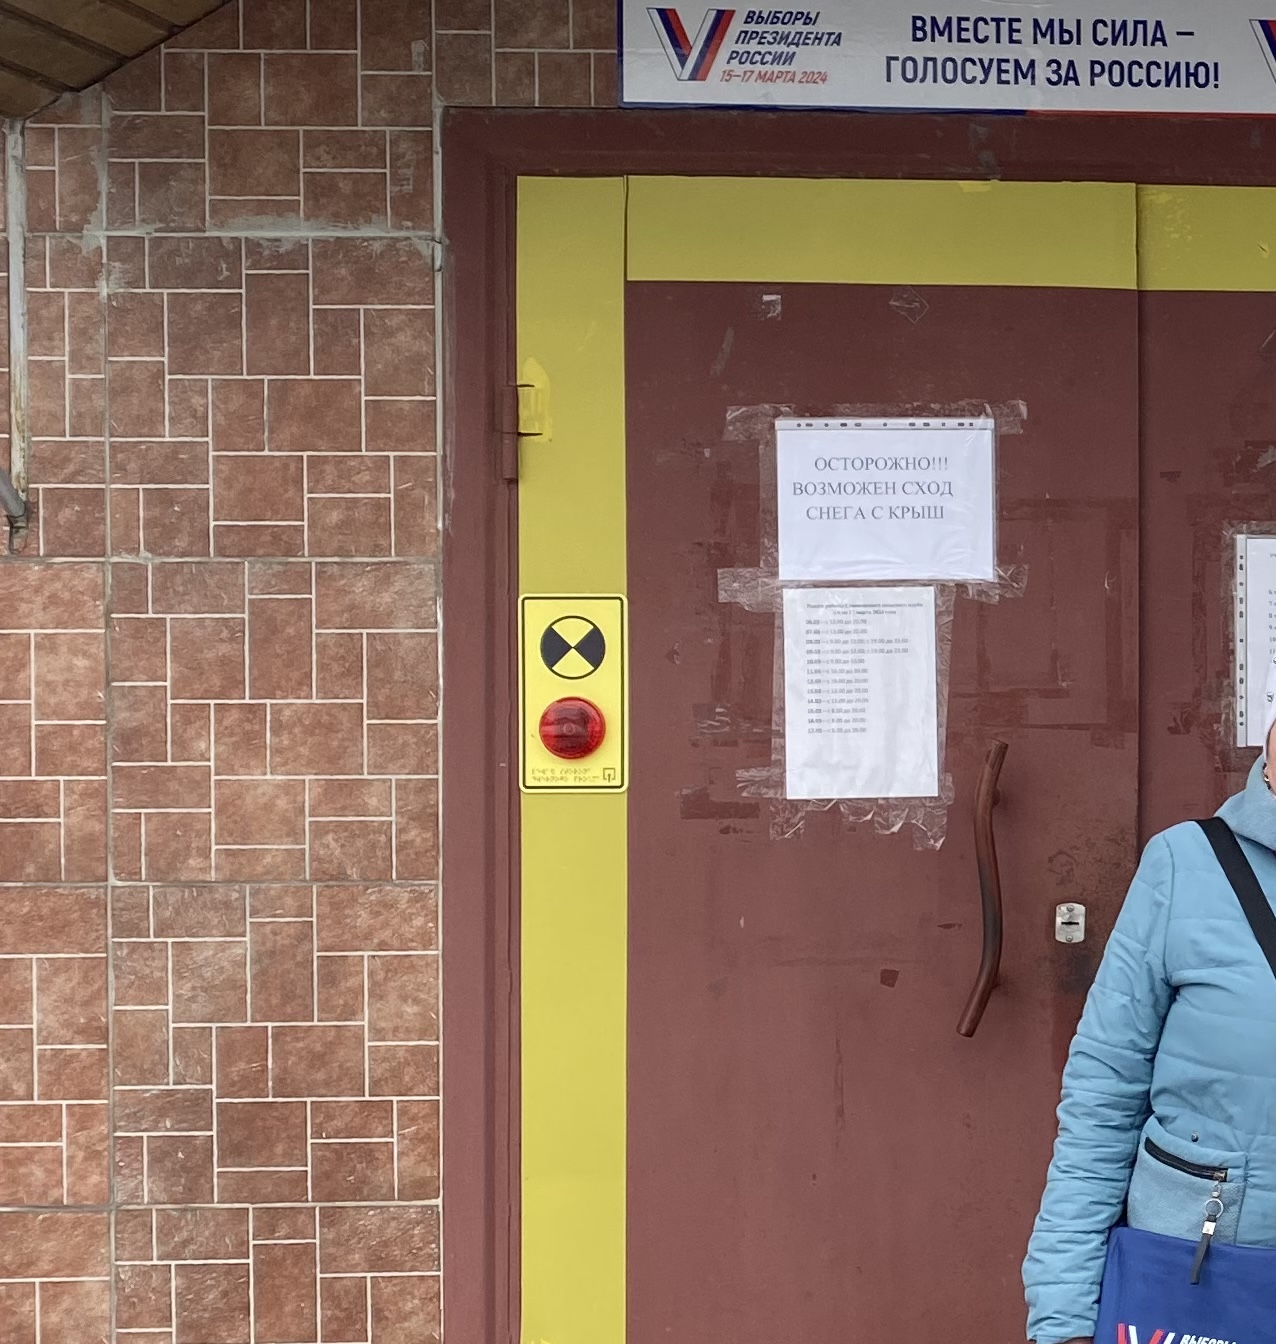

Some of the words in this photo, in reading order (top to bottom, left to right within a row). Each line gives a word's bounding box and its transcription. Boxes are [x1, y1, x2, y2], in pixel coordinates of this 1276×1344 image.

[743, 10, 821, 26] ВЫБОРЫ
[734, 30, 843, 48] ПРЕЗИДЕНТА
[911, 15, 1023, 44] ВМЕСТЕ
[1032, 17, 1082, 46] МЫ
[1091, 19, 1168, 47] СИЛА
[726, 50, 797, 66] РОССИИ
[755, 70, 796, 84] МАРТА
[798, 70, 829, 85] 2024
[885, 55, 1036, 86] ГОЛОСУЕМ
[1045, 58, 1081, 87] ЗА
[1089, 59, 1220, 89] РОССИЮ!
[814, 456, 948, 471] ОСТОРОЖНО!!!
[792, 481, 896, 496] ВОЗМОЖЕН
[901, 481, 954, 497] СХОД
[806, 505, 866, 520] СНЕГА
[871, 506, 884, 520] С
[888, 505, 945, 520] КРЫШ
